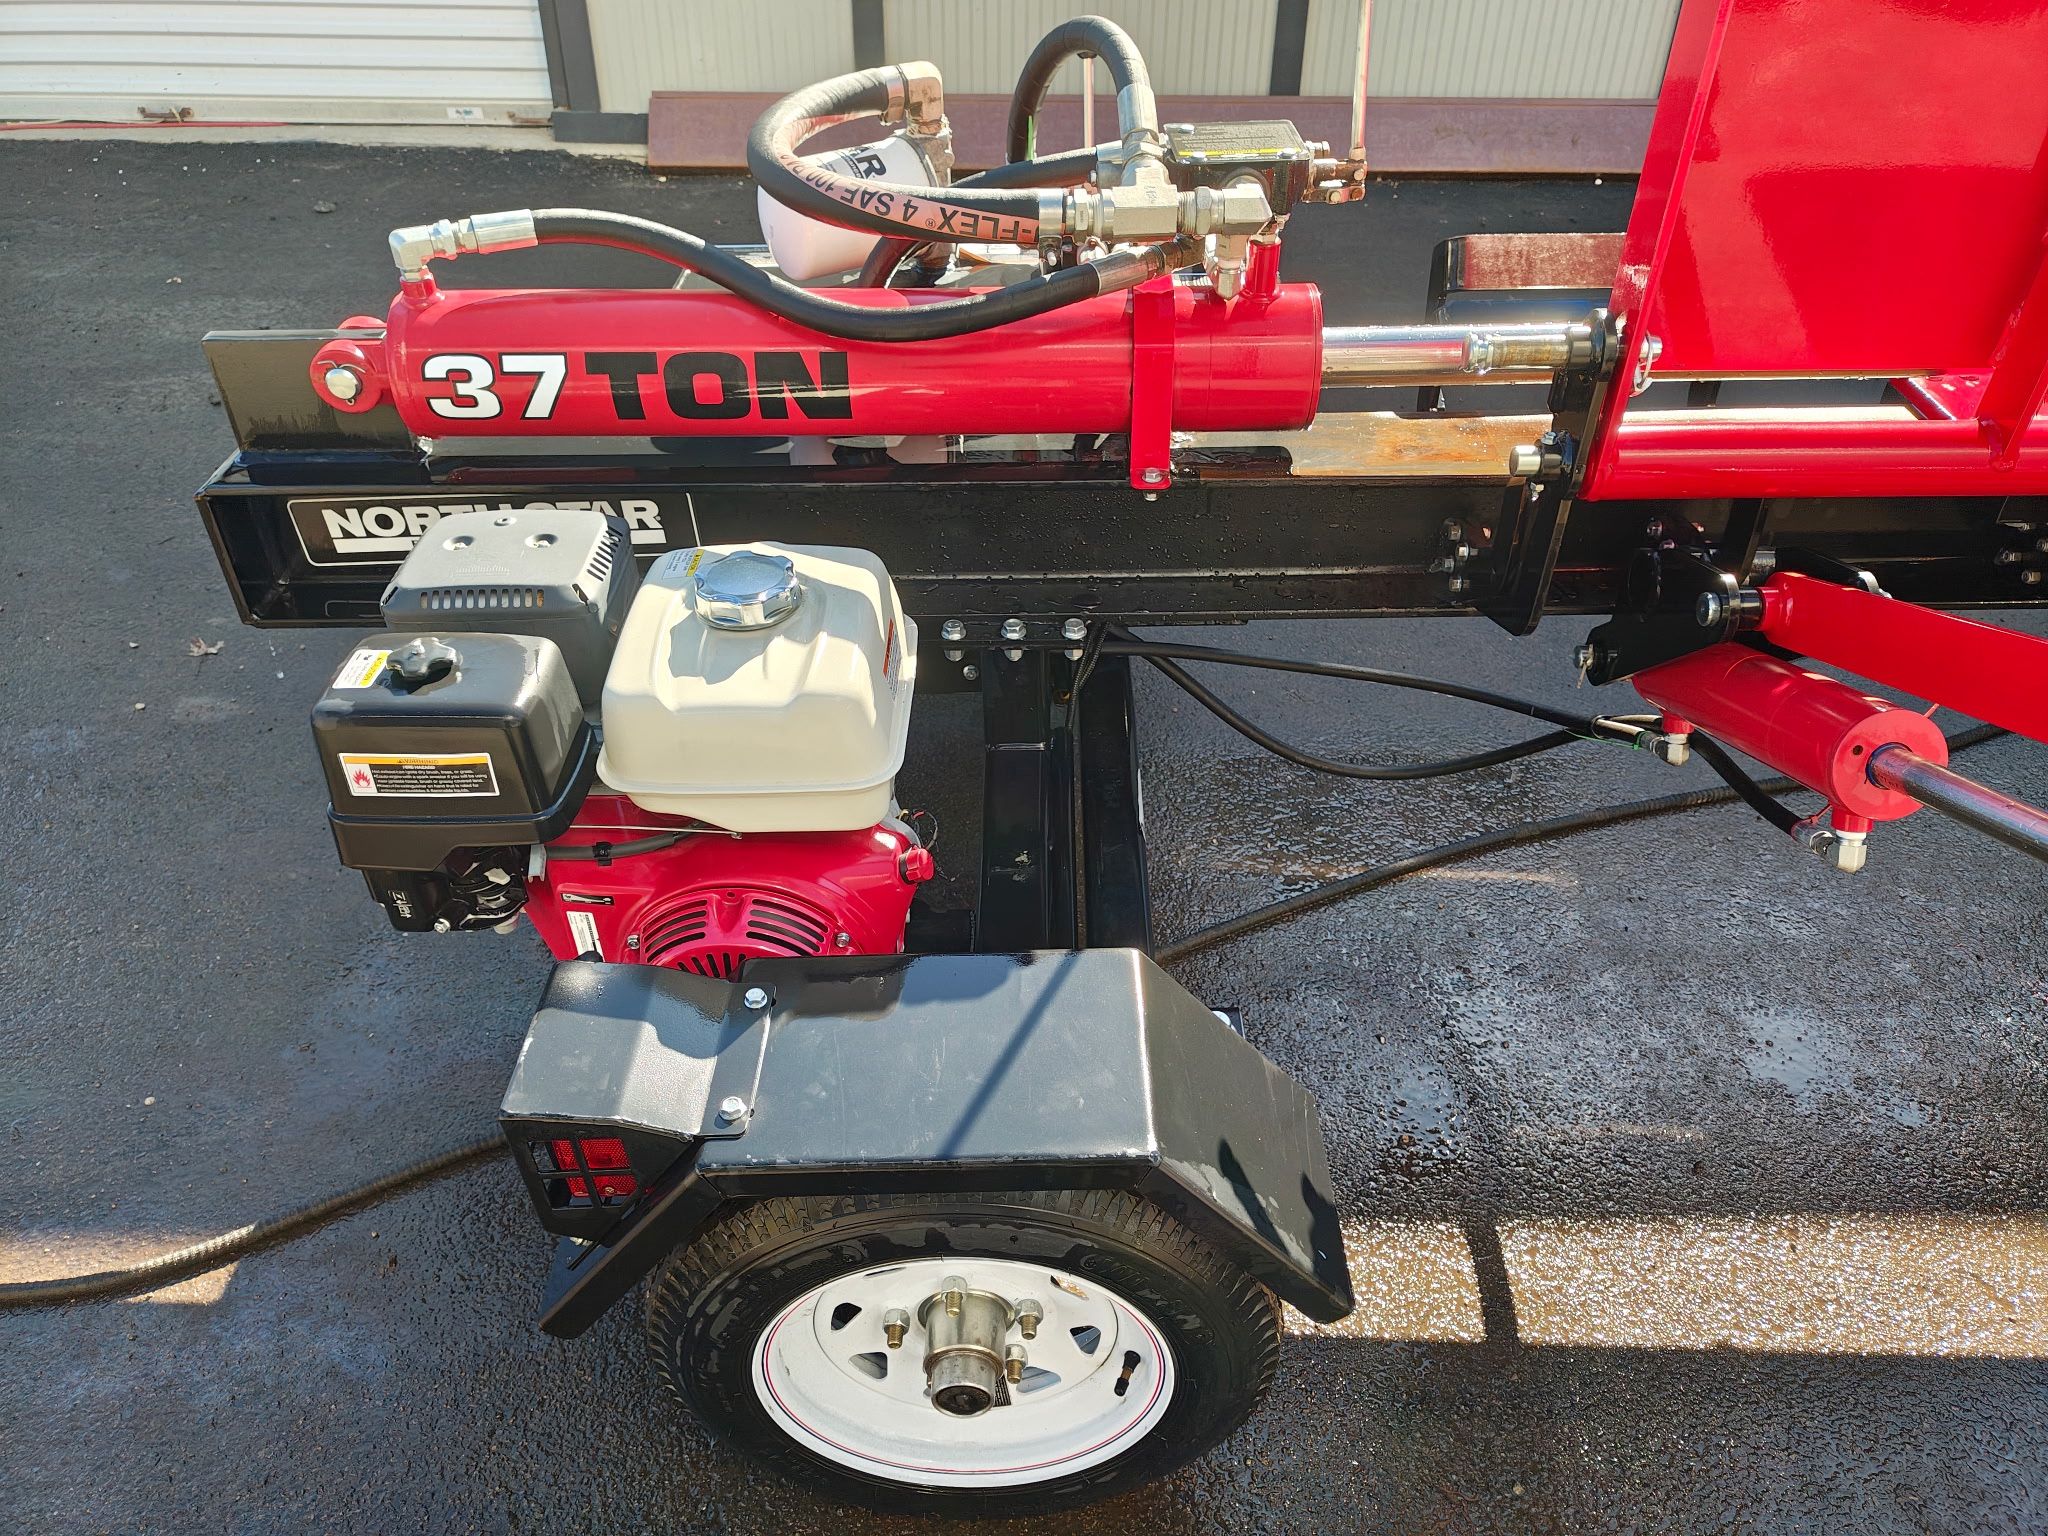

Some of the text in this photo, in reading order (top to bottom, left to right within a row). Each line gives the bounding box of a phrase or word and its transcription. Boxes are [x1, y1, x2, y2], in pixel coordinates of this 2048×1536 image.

[902, 199, 918, 222] 4
[421, 351, 853, 420] 37 TON
